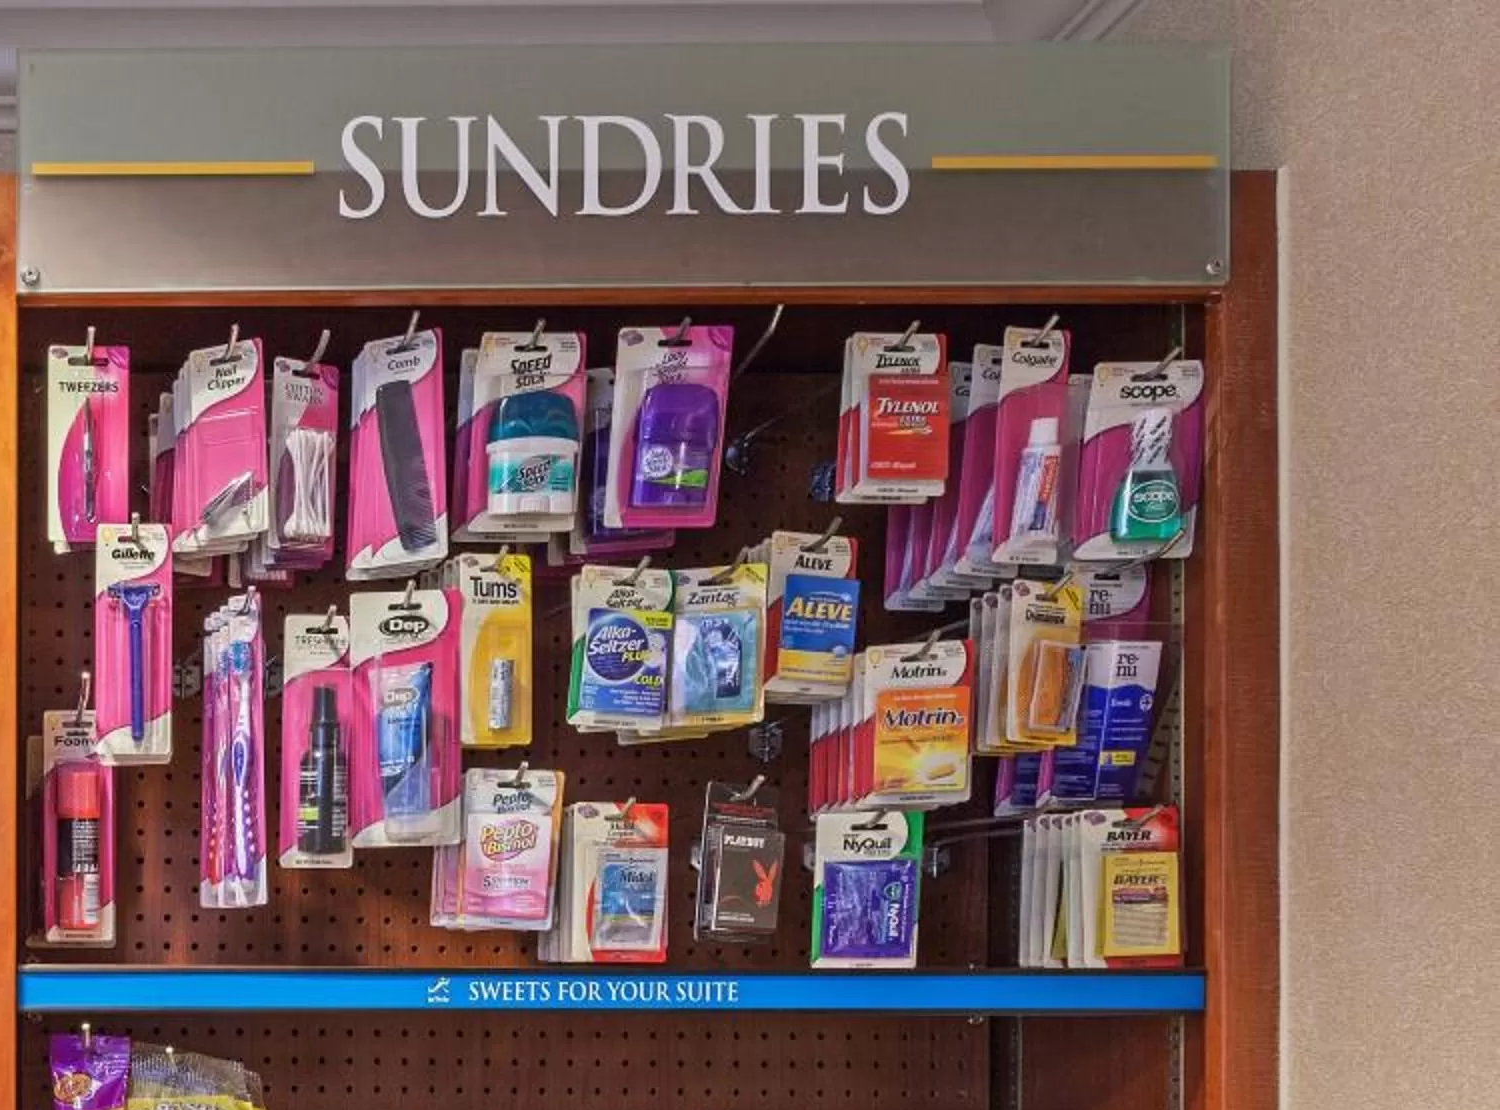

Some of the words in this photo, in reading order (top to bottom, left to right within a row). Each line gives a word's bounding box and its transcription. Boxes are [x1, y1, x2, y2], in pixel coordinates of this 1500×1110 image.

[338, 111, 910, 219] SUNDRIES
[387, 355, 421, 371] Comb
[876, 354, 922, 369] TYLENOL
[215, 366, 238, 379] Nail
[59, 381, 119, 394] TWEEZERS
[207, 376, 246, 392] Clipper
[1120, 384, 1177, 402] scope
[875, 397, 940, 416] TYLENOL
[795, 554, 833, 571] ALEVE
[470, 577, 518, 600] Tums
[786, 596, 853, 622] ALEVE
[588, 638, 645, 656] Seltzer
[891, 663, 942, 680] Motrin
[885, 707, 958, 728] Motrin
[842, 836, 892, 854] NyQuil
[1106, 830, 1152, 842] BAYER
[468, 980, 551, 1002] SWEETS
[557, 981, 602, 1002] FOR
[607, 981, 670, 1002] YOUR
[675, 981, 740, 1002] SUITE
